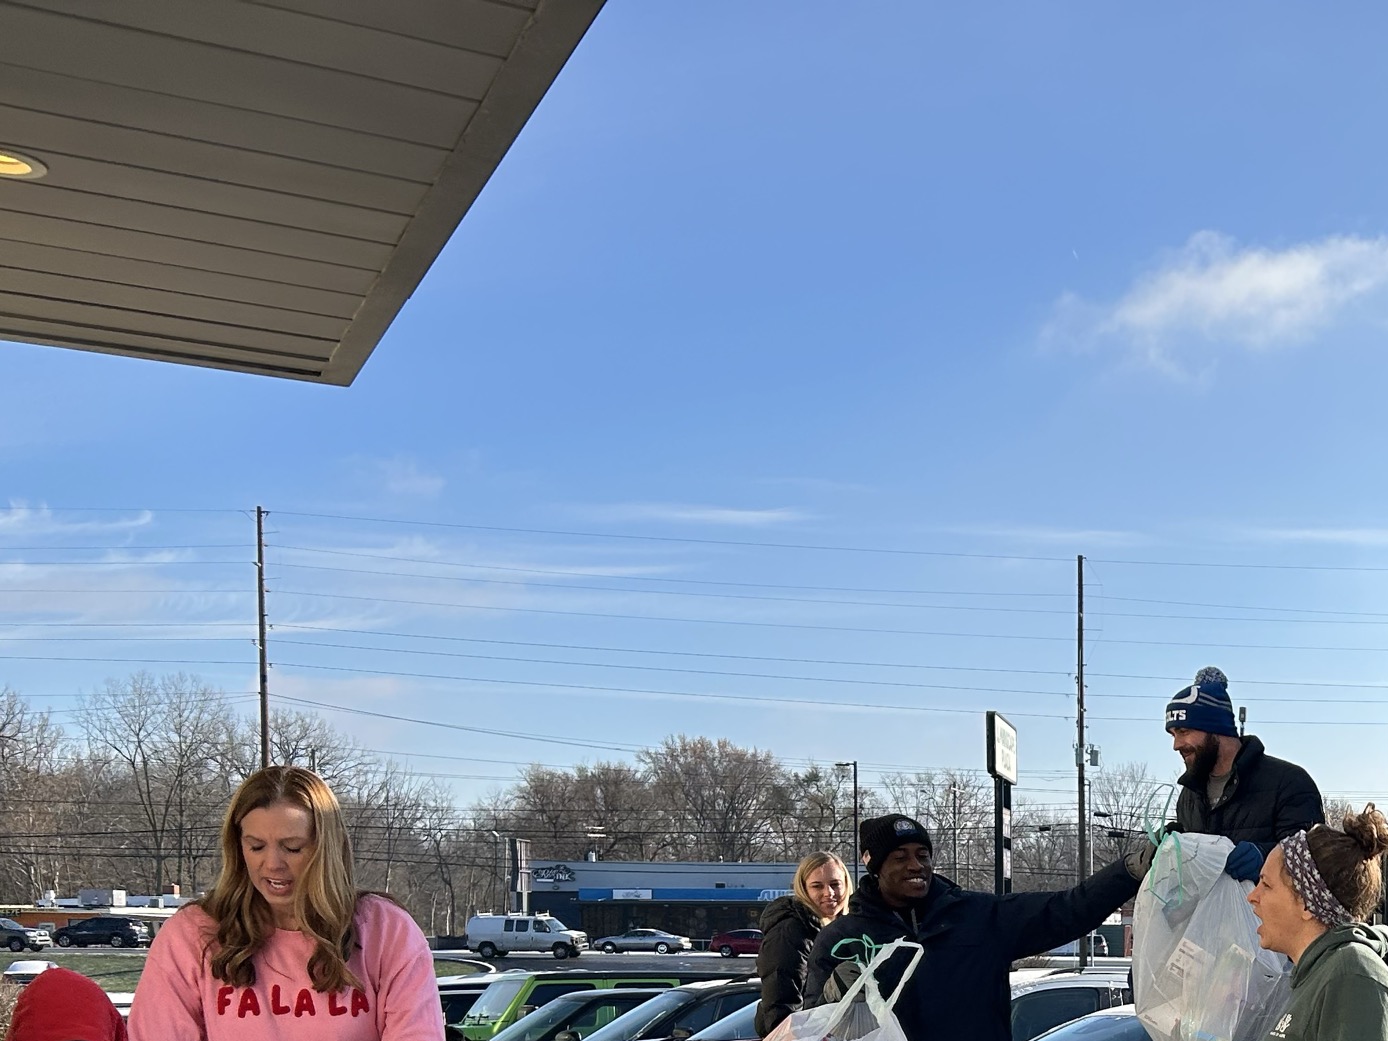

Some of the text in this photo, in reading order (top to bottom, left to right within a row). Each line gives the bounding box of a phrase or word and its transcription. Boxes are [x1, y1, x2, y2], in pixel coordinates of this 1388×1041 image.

[1166, 709, 1187, 722] LTS
[217, 984, 370, 1018] FA LA LA
